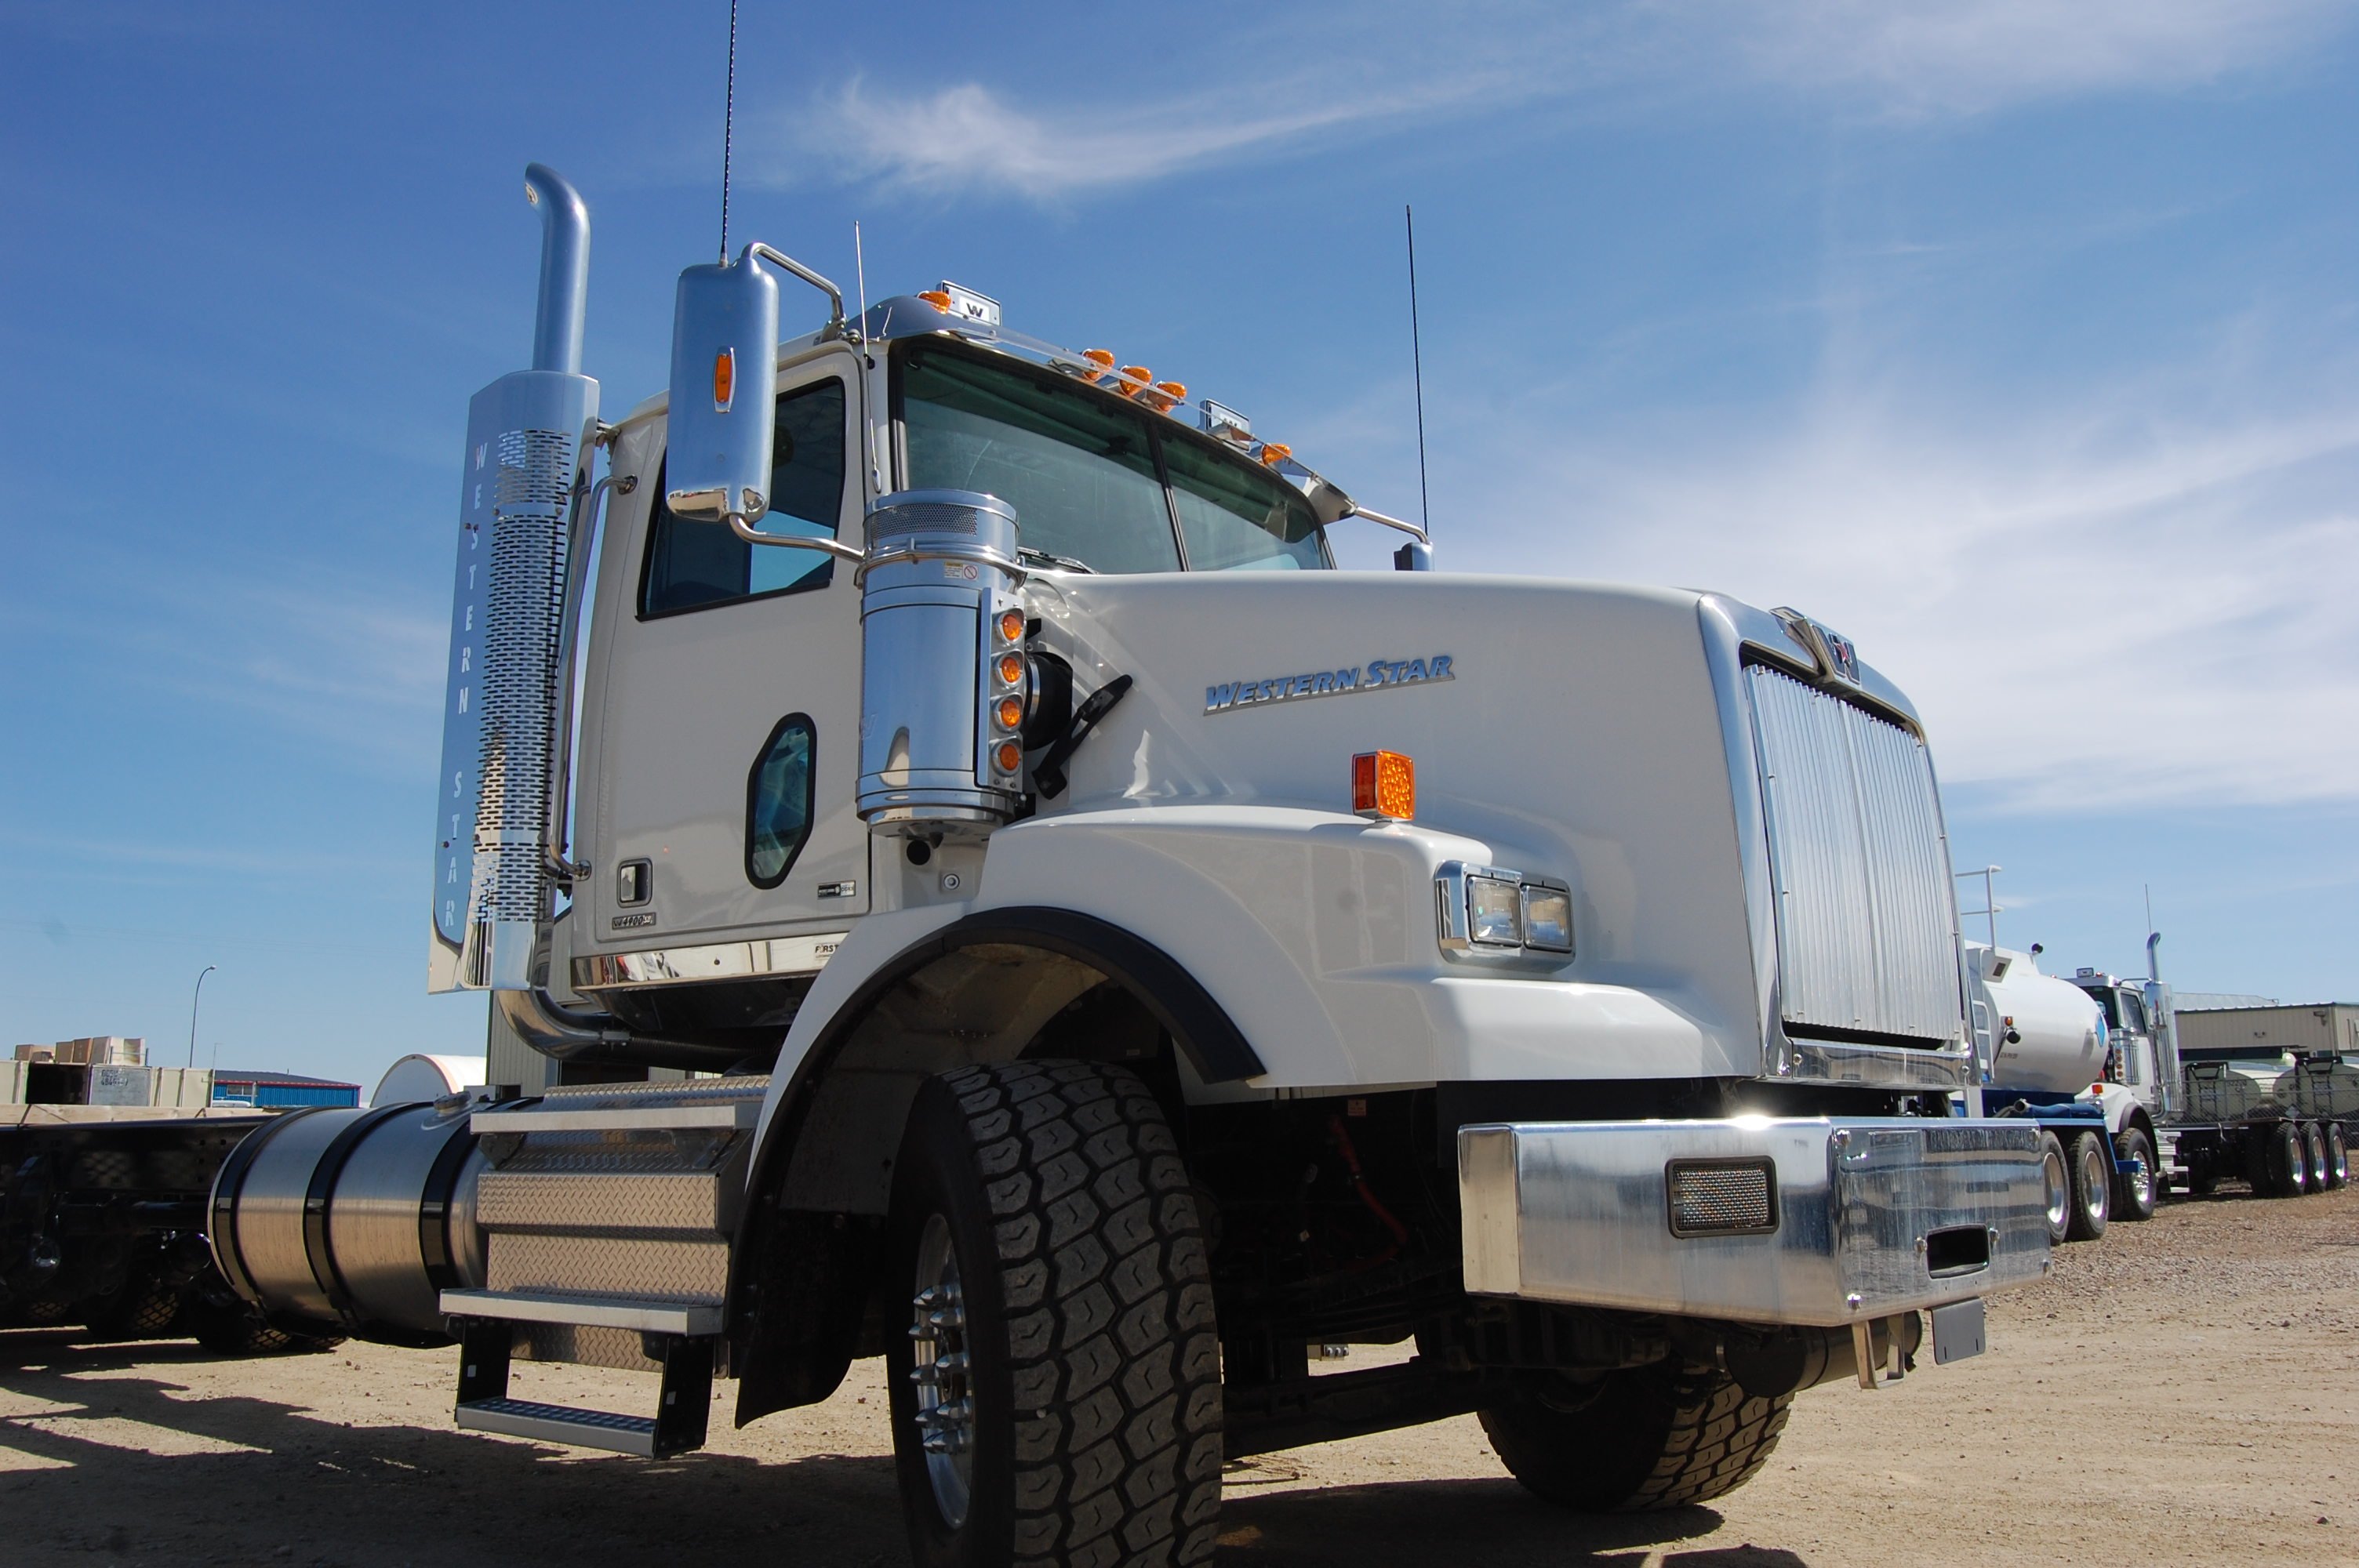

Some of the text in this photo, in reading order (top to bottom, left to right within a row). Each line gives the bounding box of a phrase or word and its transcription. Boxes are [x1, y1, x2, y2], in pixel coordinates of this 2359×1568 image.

[445, 441, 489, 927] WESTERN STAR
[1205, 654, 1454, 711] WESTERN STAR
